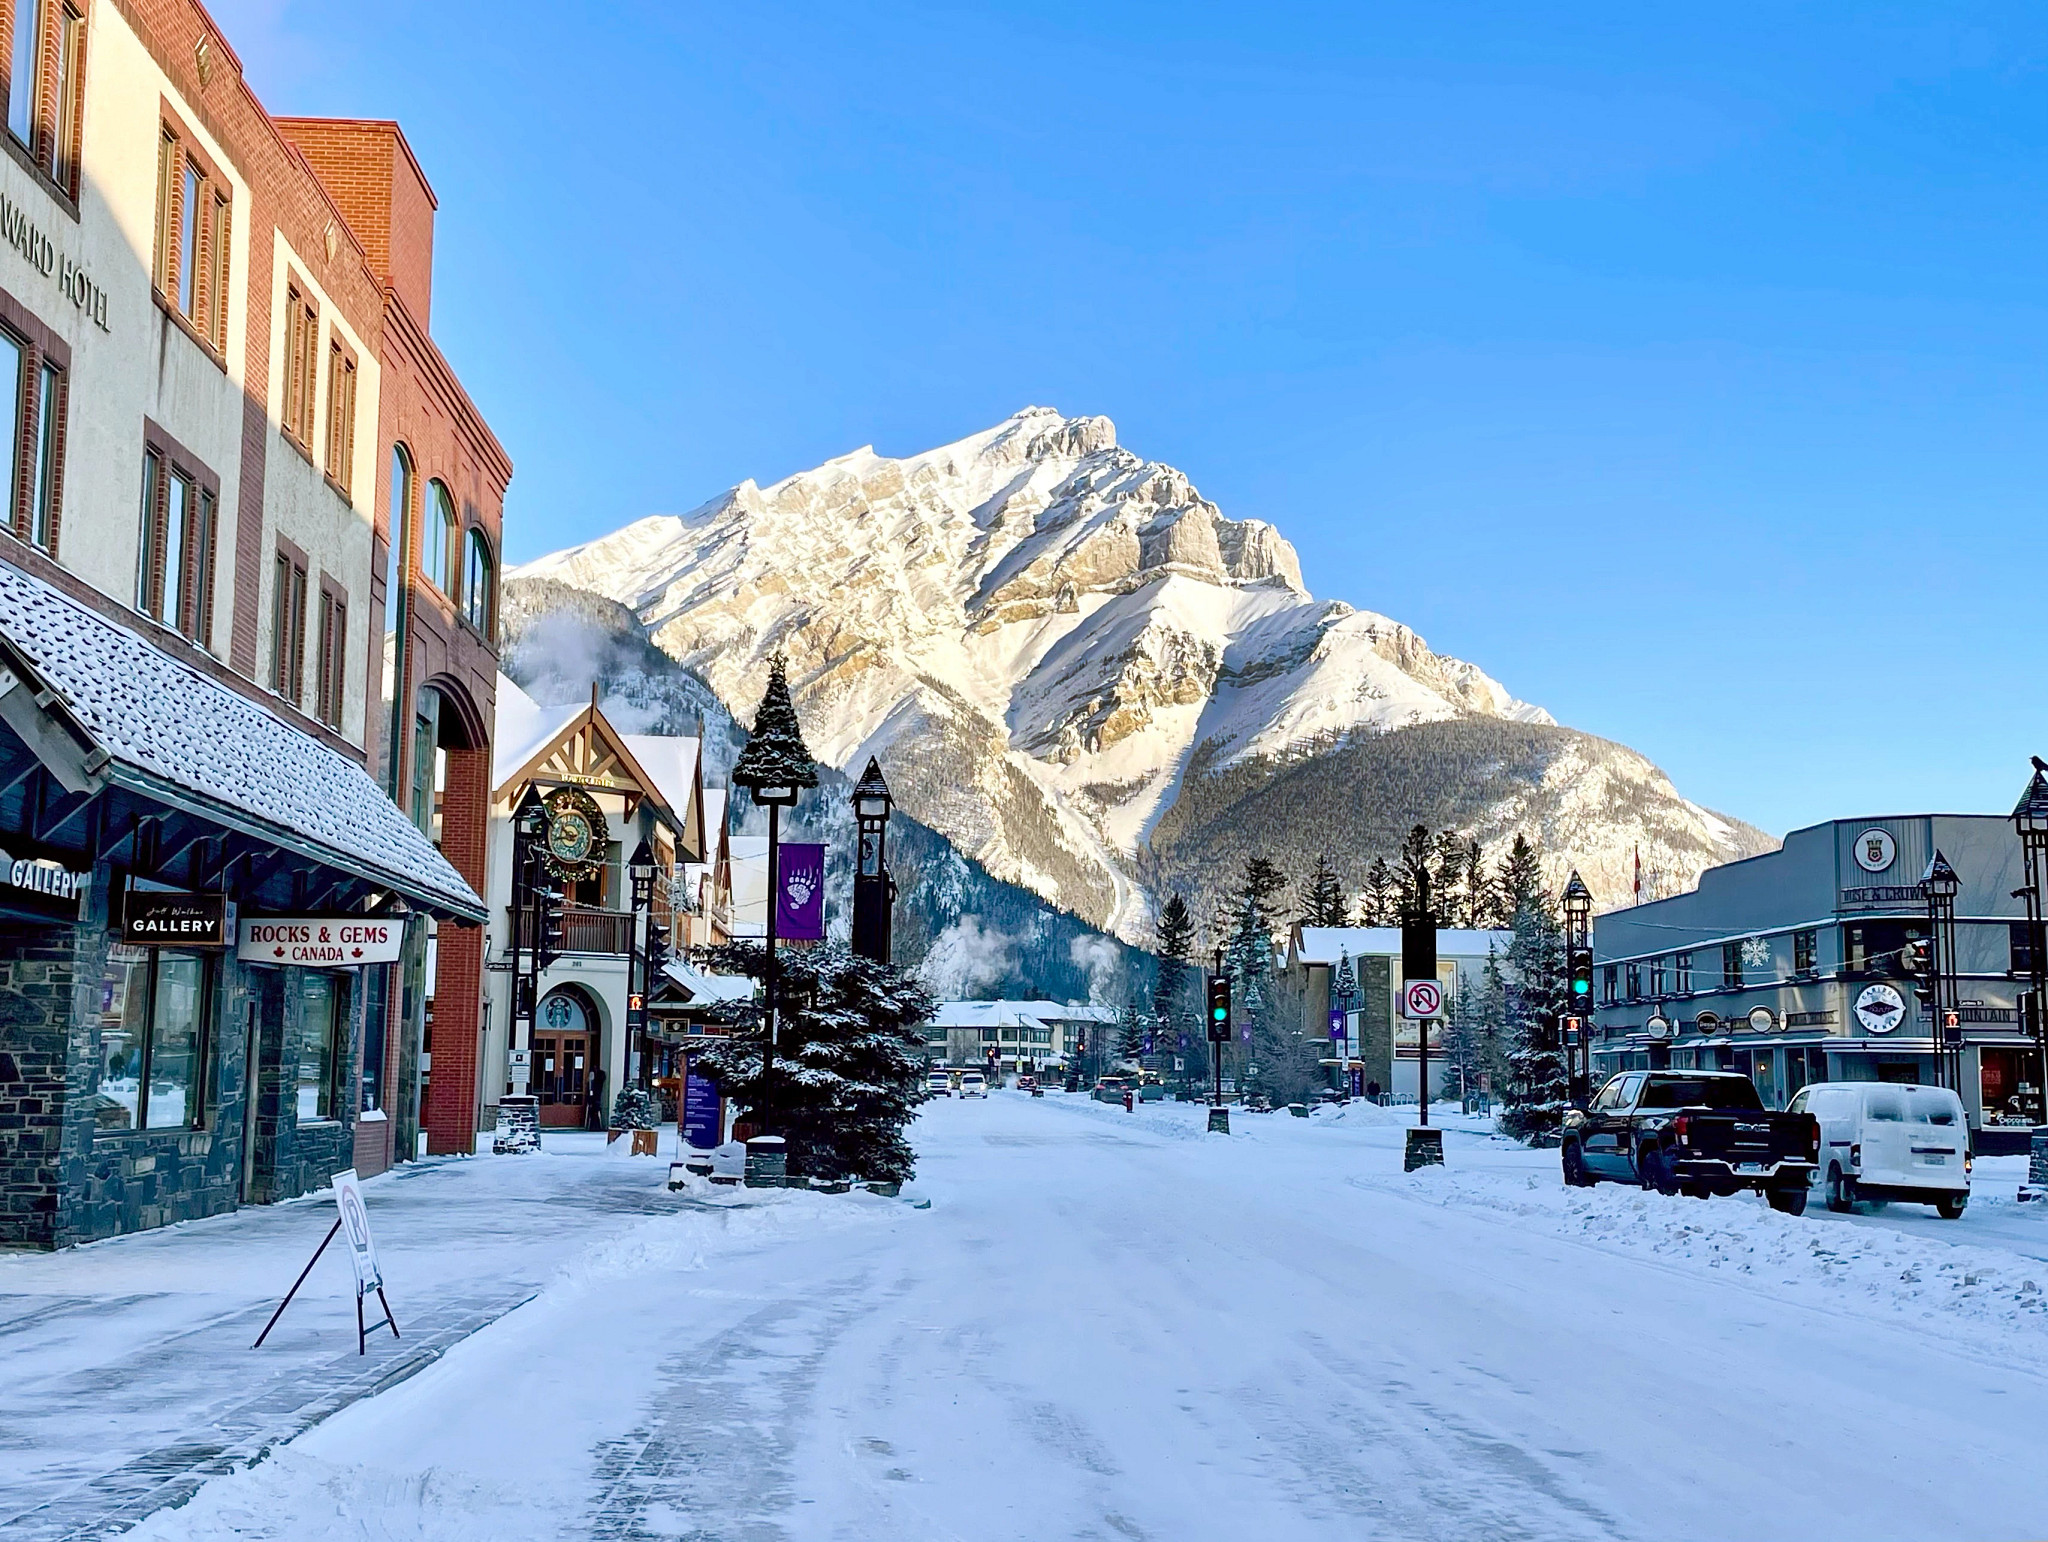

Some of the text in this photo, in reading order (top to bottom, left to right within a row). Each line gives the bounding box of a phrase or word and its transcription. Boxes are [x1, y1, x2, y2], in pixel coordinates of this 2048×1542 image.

[59, 252, 111, 334] HOTEL
[11, 860, 80, 900] GALLERY
[133, 920, 215, 932] GALLERY
[250, 926, 388, 943] ROCKS & GEMS
[292, 946, 344, 961] CANADA
[1861, 986, 1898, 1000] CARIBOU
[1862, 1017, 1897, 1030] CORNER
